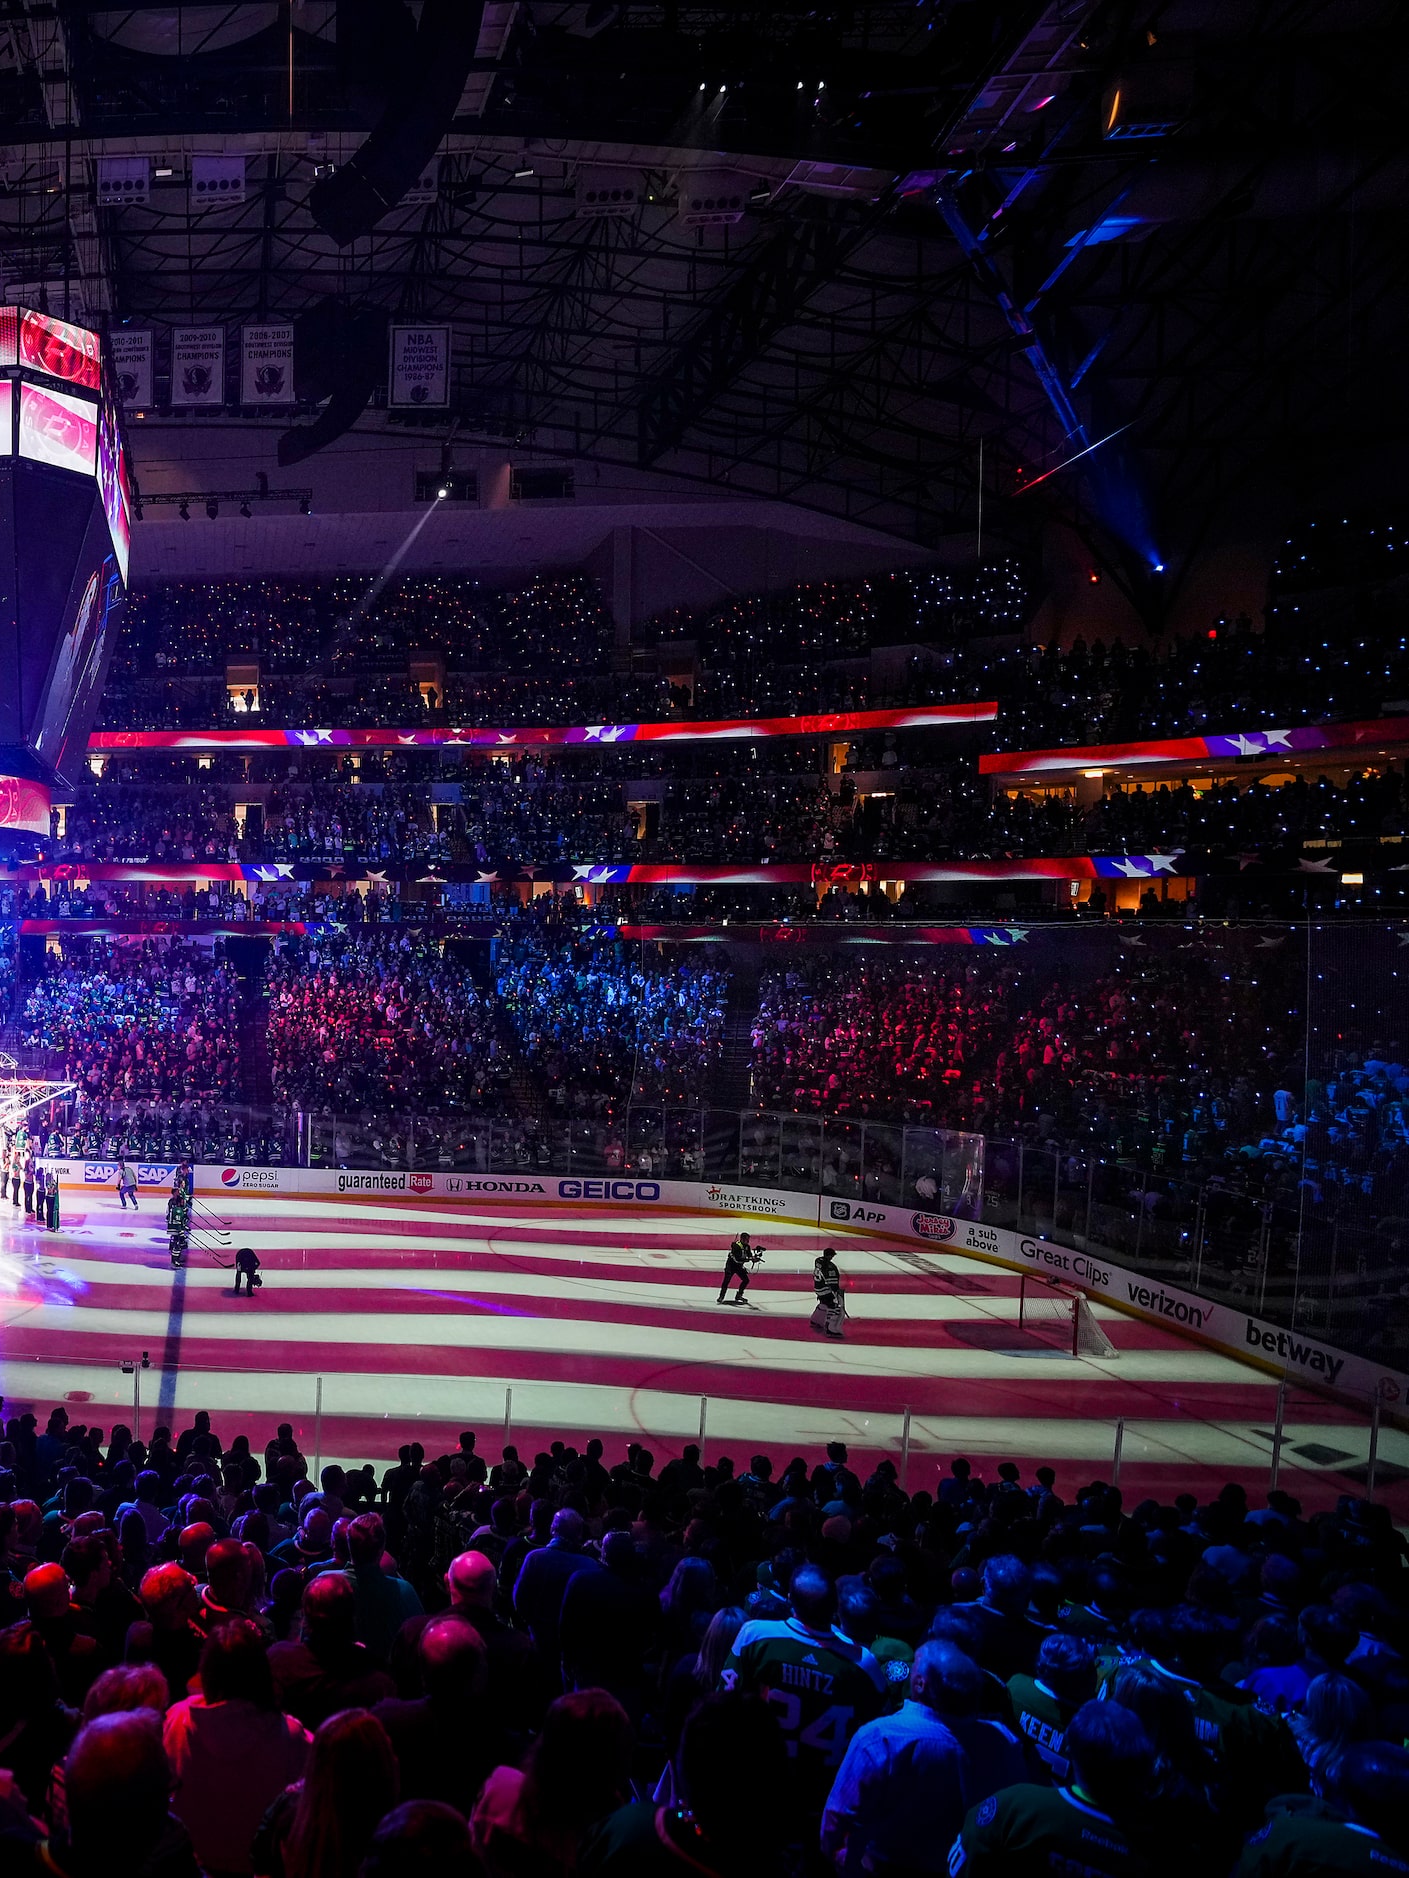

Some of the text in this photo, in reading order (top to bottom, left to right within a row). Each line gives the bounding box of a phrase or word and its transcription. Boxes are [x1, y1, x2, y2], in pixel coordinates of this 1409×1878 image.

[407, 334, 434, 345] NBA
[177, 351, 220, 360] CHAMPIONS
[248, 350, 292, 359] CHAMPIONS
[403, 346, 438, 354] MIDWEST
[397, 363, 444, 372] CHAMPIONS
[85, 1166, 116, 1181] SAP
[138, 1167, 169, 1182] SAP
[243, 1170, 278, 1182] pepsi
[338, 1173, 432, 1191] guaranteed Rate
[465, 1180, 546, 1193] HONDA
[558, 1180, 660, 1200] GEICO
[709, 1192, 786, 1207] DRAFTKINGS
[719, 1201, 777, 1214] SPORTSBOOK
[917, 1214, 950, 1228] Jersey
[968, 1227, 997, 1240] a sub
[966, 1237, 999, 1252] above
[1020, 1239, 1110, 1286] Great Clips
[1128, 1282, 1203, 1328] verizon
[1245, 1319, 1345, 1382] betway
[781, 1662, 836, 1696] HINTZ
